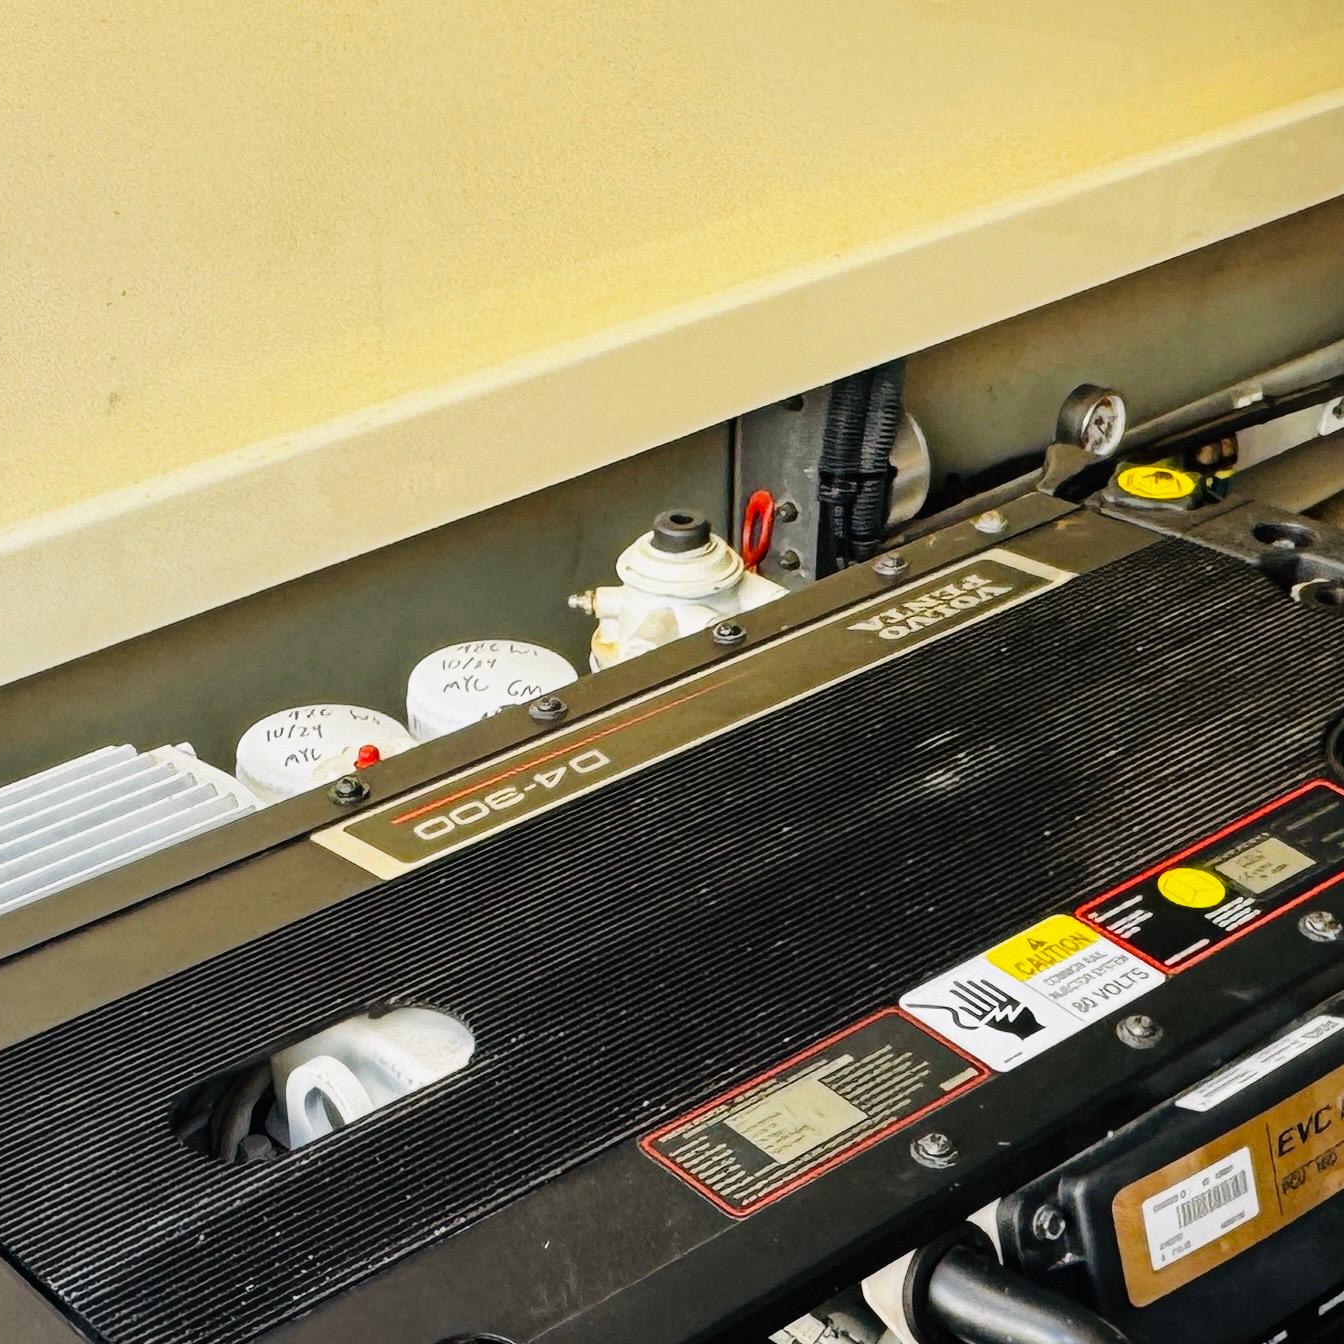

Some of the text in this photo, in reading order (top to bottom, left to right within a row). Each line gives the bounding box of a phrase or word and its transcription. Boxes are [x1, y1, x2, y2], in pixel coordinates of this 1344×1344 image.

[846, 574, 993, 631] PENTA
[879, 585, 1014, 640] VOLVO
[507, 679, 543, 698] GM
[413, 749, 611, 841] D4-300
[1013, 932, 1093, 977] CAUTION
[1092, 967, 1150, 1001] VOLTS
[1276, 1104, 1333, 1157] EVC
